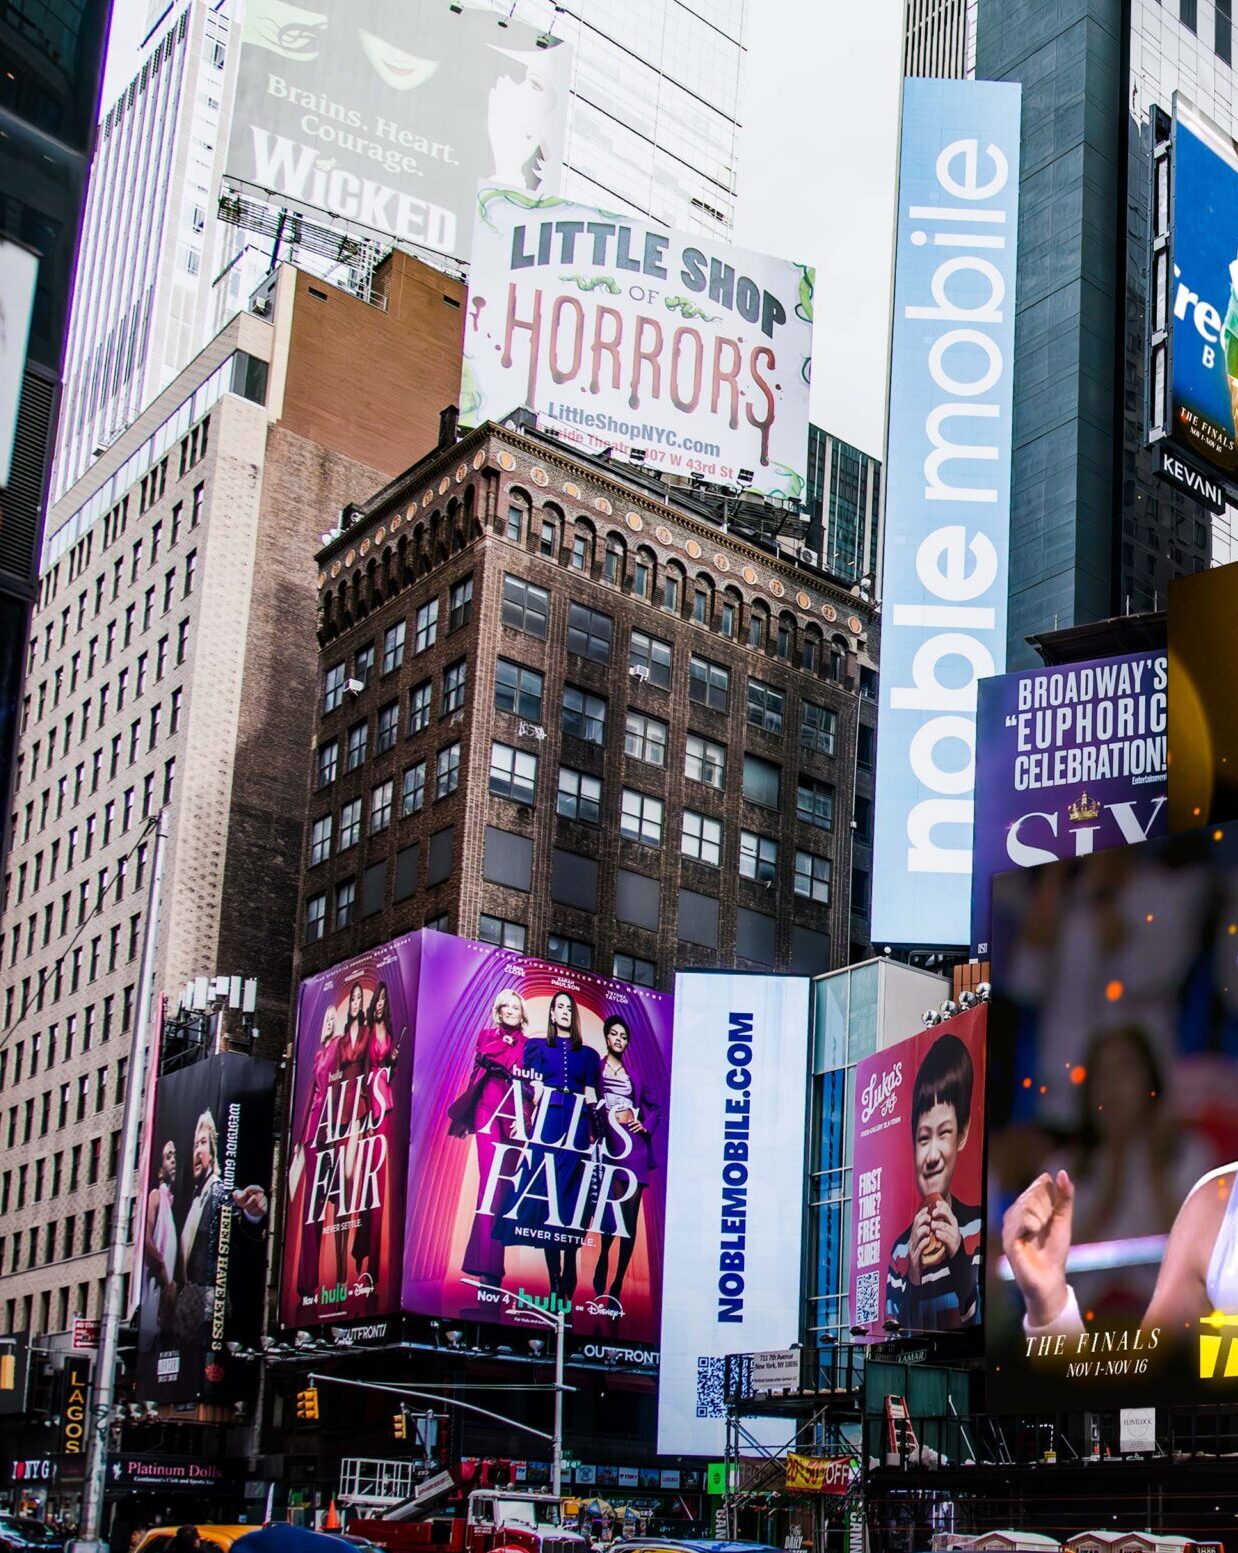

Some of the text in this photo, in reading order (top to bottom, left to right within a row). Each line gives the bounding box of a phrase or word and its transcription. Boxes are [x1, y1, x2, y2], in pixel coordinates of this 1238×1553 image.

[267, 73, 460, 168] Brains. Heart.
[300, 113, 425, 178] Courage.
[509, 221, 788, 340] LITTLE SHOP
[628, 285, 660, 308] OF
[500, 282, 780, 468] HORRORS
[549, 401, 721, 458] LittleShopNYC.com
[1180, 407, 1236, 450] THE FINALS
[669, 453, 684, 467] W
[686, 456, 717, 476] 43rd
[719, 465, 734, 481] St
[1163, 453, 1223, 506] KEVANI
[888, 137, 1009, 875] noble mobile
[1014, 735, 1168, 791] CELEBRATION!
[512, 1066, 544, 1084] hulu
[304, 1132, 387, 1225] FAIR
[717, 1012, 755, 1325] NOBLEMOBILE.COM
[859, 1167, 882, 1197] FIRST
[475, 1140, 639, 1240] FAIR
[858, 1191, 881, 1221] TIME?
[218, 1205, 232, 1255] HEELS
[514, 1226, 597, 1247] NEVER SETTLE.
[857, 1215, 880, 1245] FREE
[215, 1256, 229, 1298] HAVE
[321, 1282, 348, 1304] hulu
[212, 1299, 225, 1339] EYES
[477, 1290, 500, 1303] Nov
[502, 1293, 510, 1304] 4
[518, 1288, 572, 1314] hulu
[1025, 1328, 1161, 1357] THE FINALS
[1066, 1362, 1094, 1378] NOV
[1134, 1358, 1148, 1374] 16
[64, 1370, 86, 1454] LAGOS
[127, 1461, 222, 1478] Platinum Dolls
[825, 1463, 849, 1487] OFF
